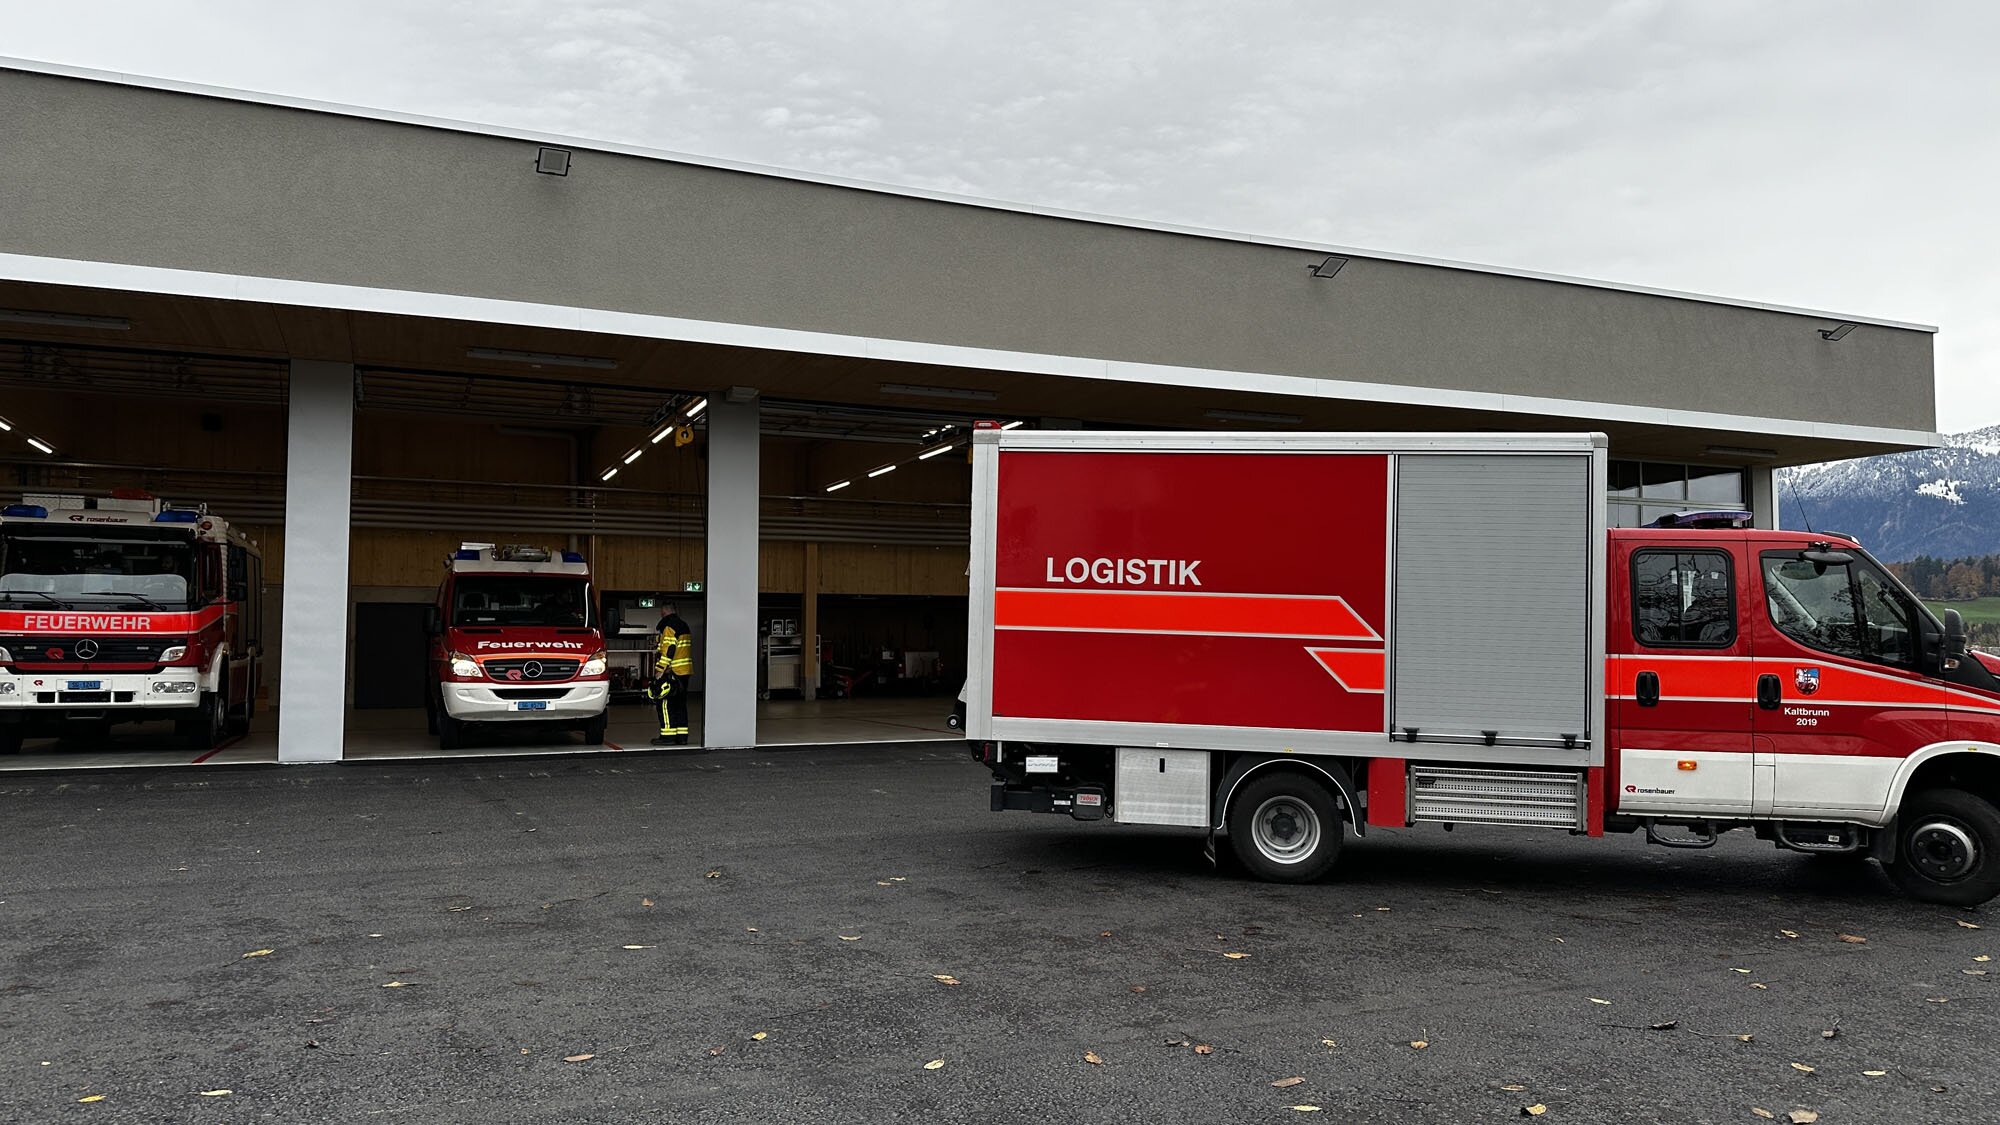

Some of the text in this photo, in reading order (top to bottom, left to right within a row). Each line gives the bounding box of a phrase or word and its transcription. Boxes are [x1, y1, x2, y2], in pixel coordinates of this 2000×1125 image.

[1046, 557, 1202, 586] LOGISTIK
[24, 615, 151, 630] FEUERWEHR
[477, 640, 584, 649] Feuerwehr
[1784, 707, 1830, 717] Kaltbrunn
[1796, 718, 1818, 727] 2019
[1637, 787, 1676, 795] rosenbauer
